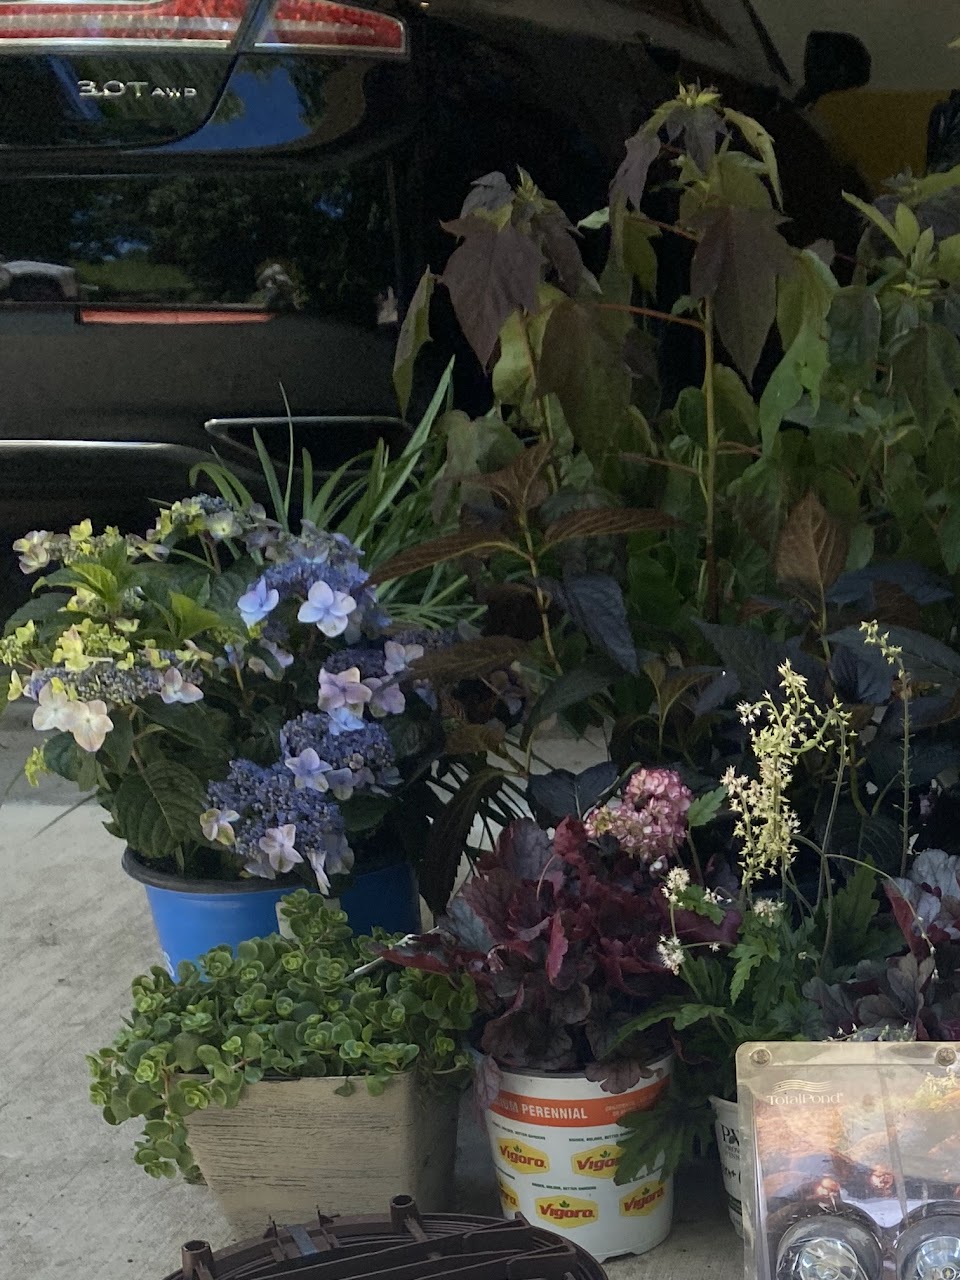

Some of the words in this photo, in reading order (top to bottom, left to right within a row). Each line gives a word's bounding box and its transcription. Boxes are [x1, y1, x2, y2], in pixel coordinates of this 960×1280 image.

[151, 86, 198, 99] AWD
[766, 1093, 840, 1106] TotalPond
[522, 1103, 588, 1120] PERENNIAL
[499, 1145, 546, 1168] Vigoro
[576, 1156, 620, 1172] Vigo
[622, 1187, 664, 1212] Vigoro
[539, 1203, 595, 1219] Vigoro
